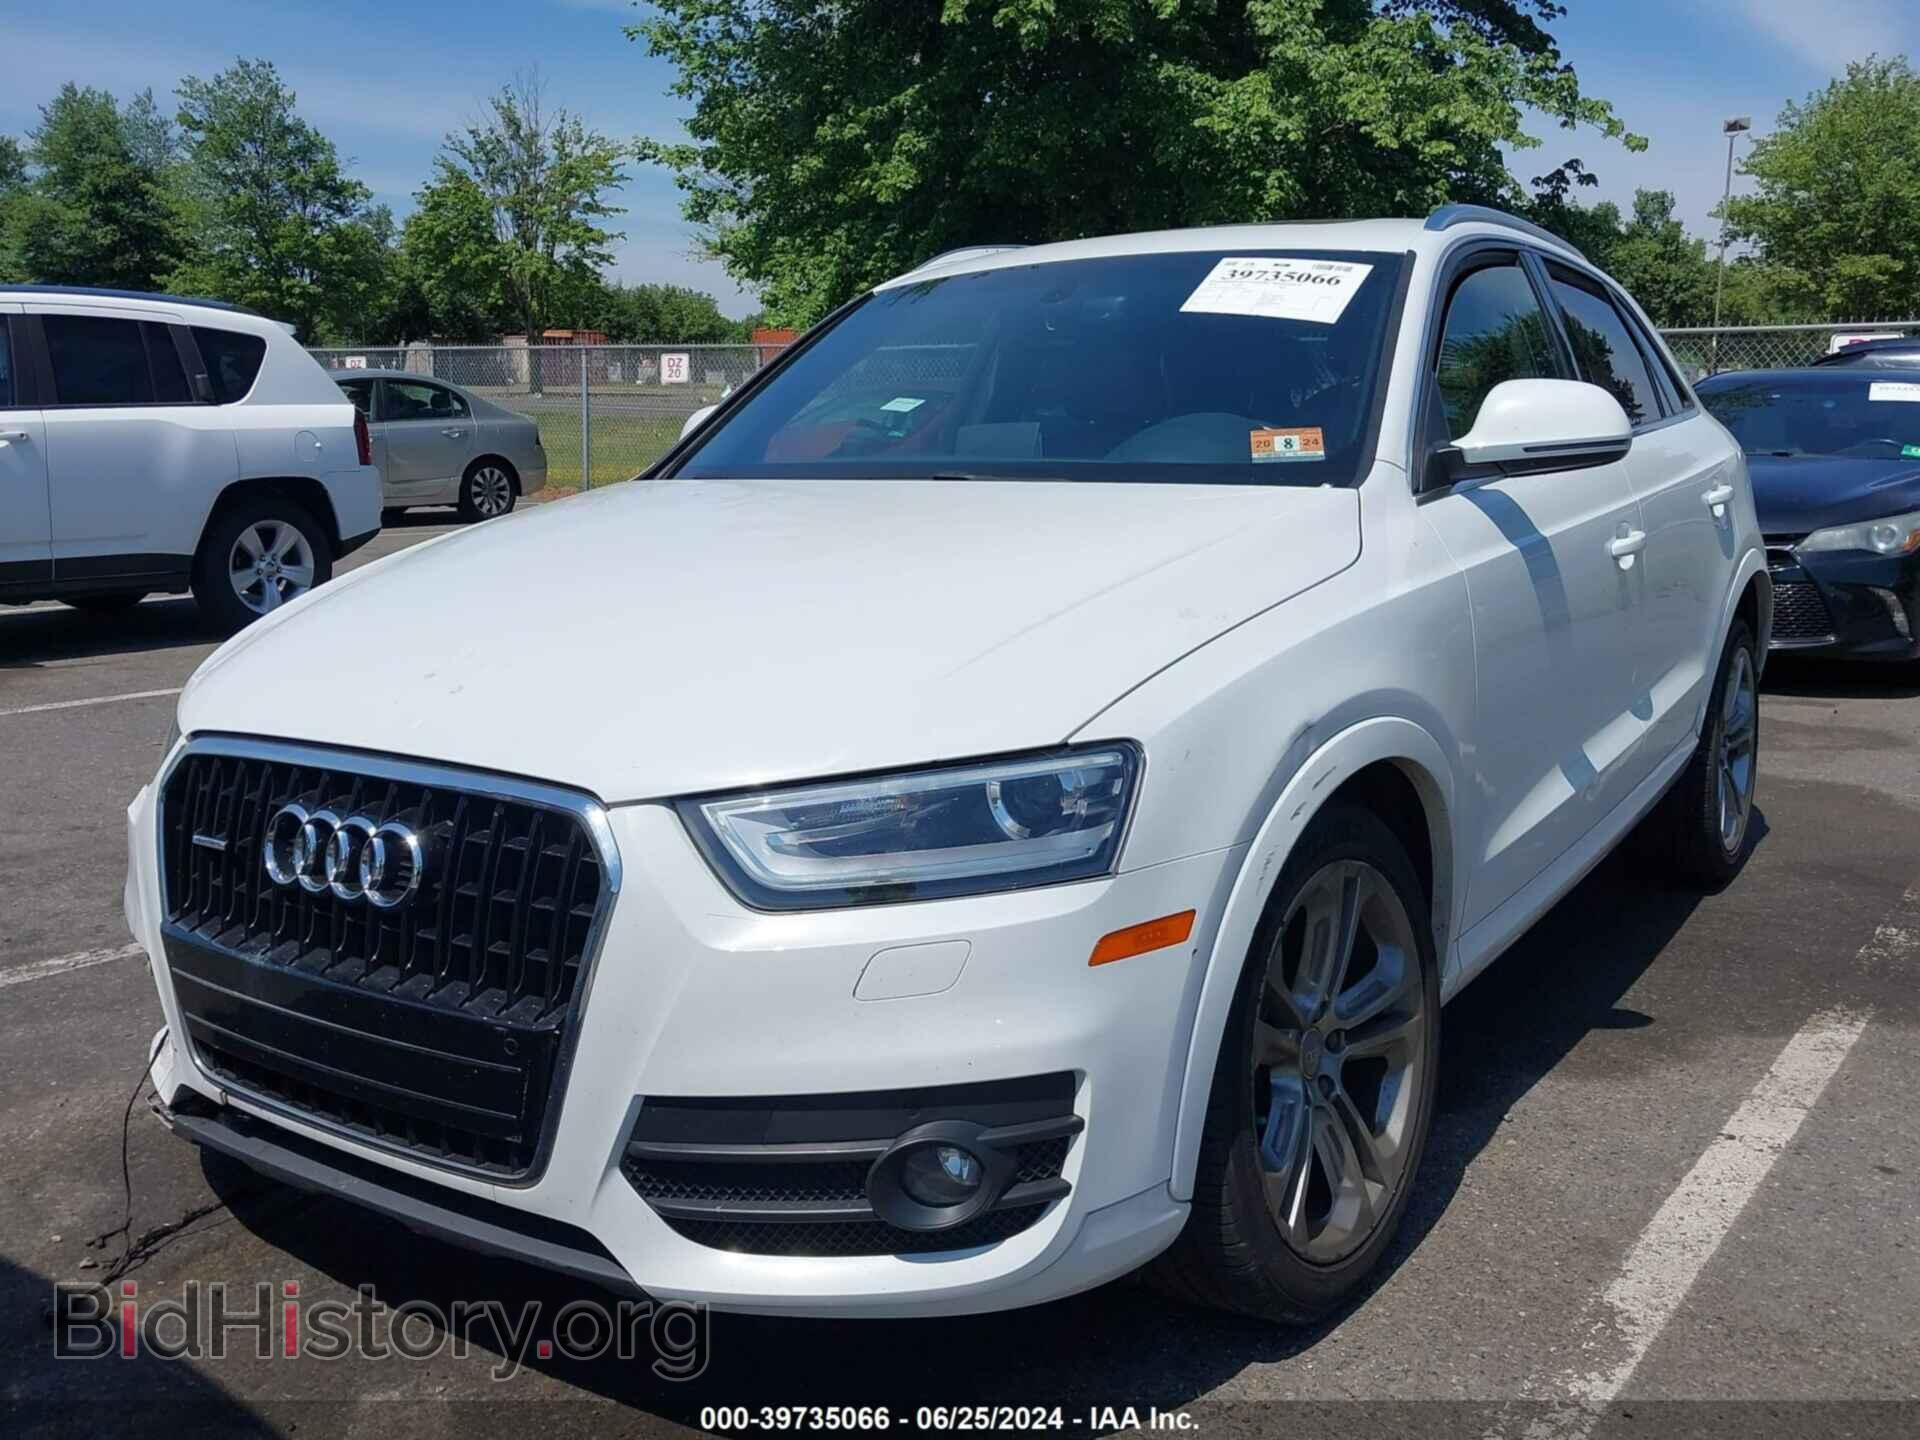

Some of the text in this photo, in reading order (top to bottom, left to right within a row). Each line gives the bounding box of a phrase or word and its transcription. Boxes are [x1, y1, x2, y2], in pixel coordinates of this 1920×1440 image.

[1221, 269, 1342, 286] 39735066
[667, 358, 683, 368] DZ
[667, 368, 681, 378] 20
[1256, 438, 1320, 449] 20 8 24
